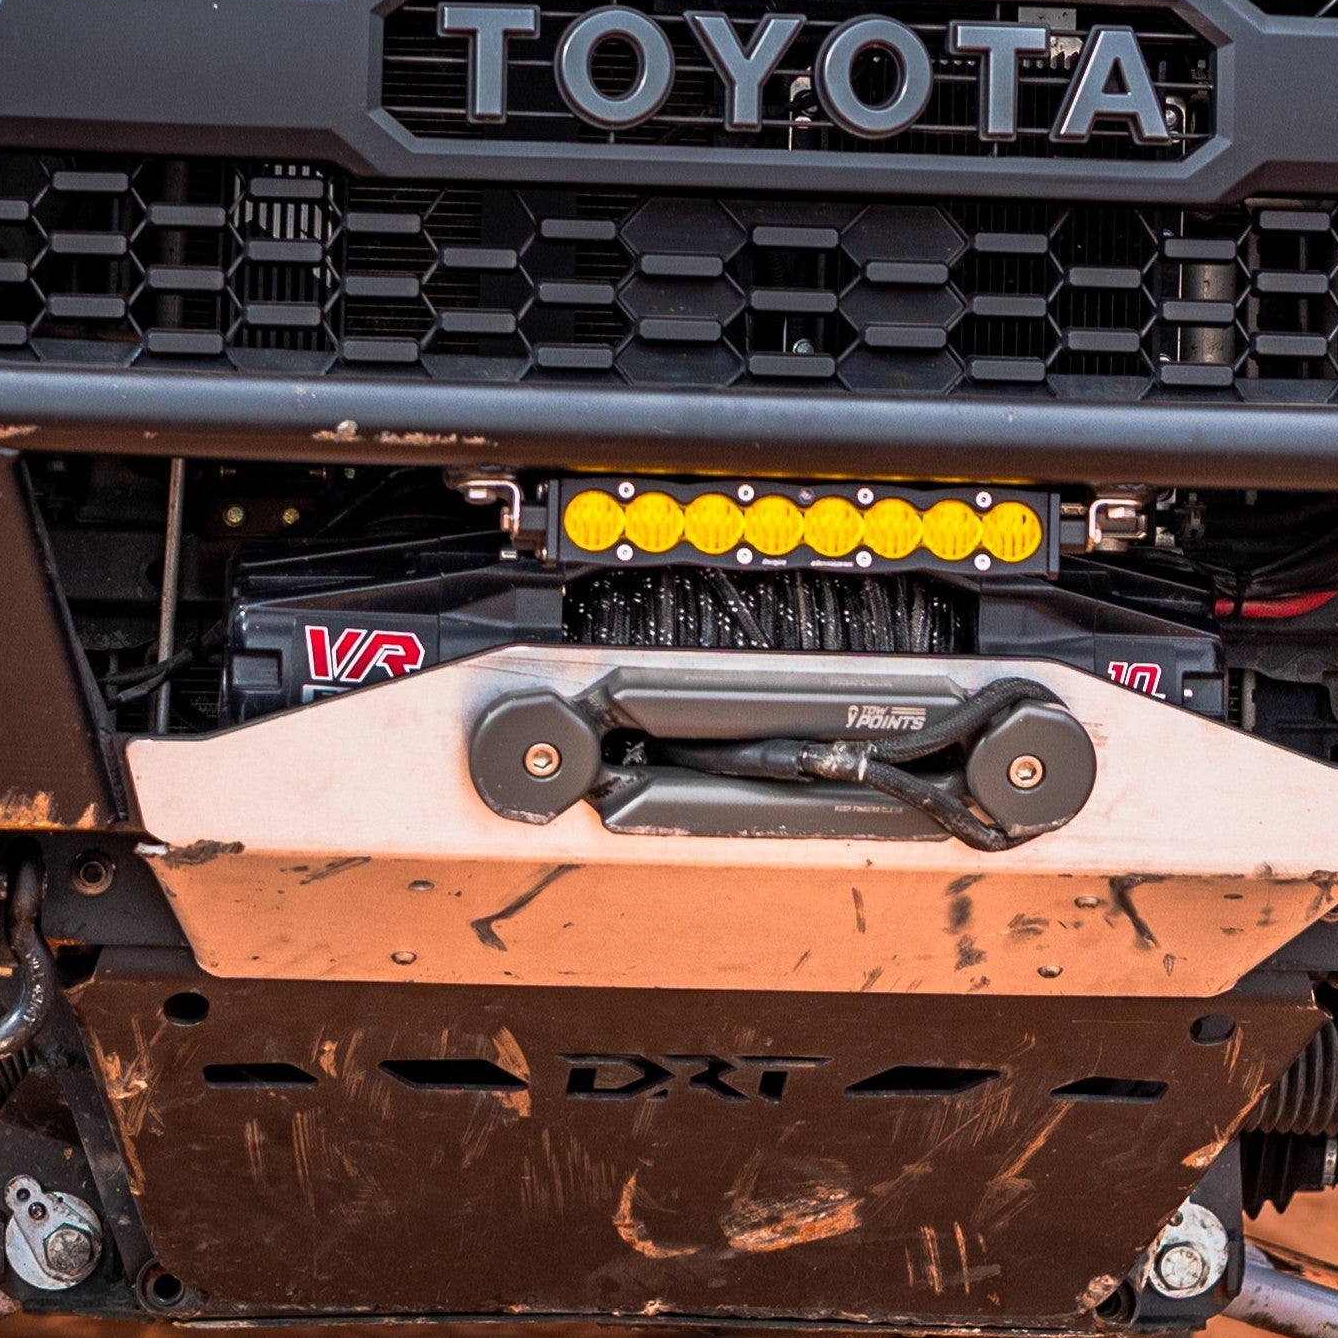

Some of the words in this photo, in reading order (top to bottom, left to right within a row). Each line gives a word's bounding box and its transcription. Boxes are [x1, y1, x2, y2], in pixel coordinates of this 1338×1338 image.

[437, 2, 1172, 146] TOYOTA
[304, 624, 426, 683] VR
[855, 715, 926, 731] POINTS
[862, 705, 889, 716] TOW
